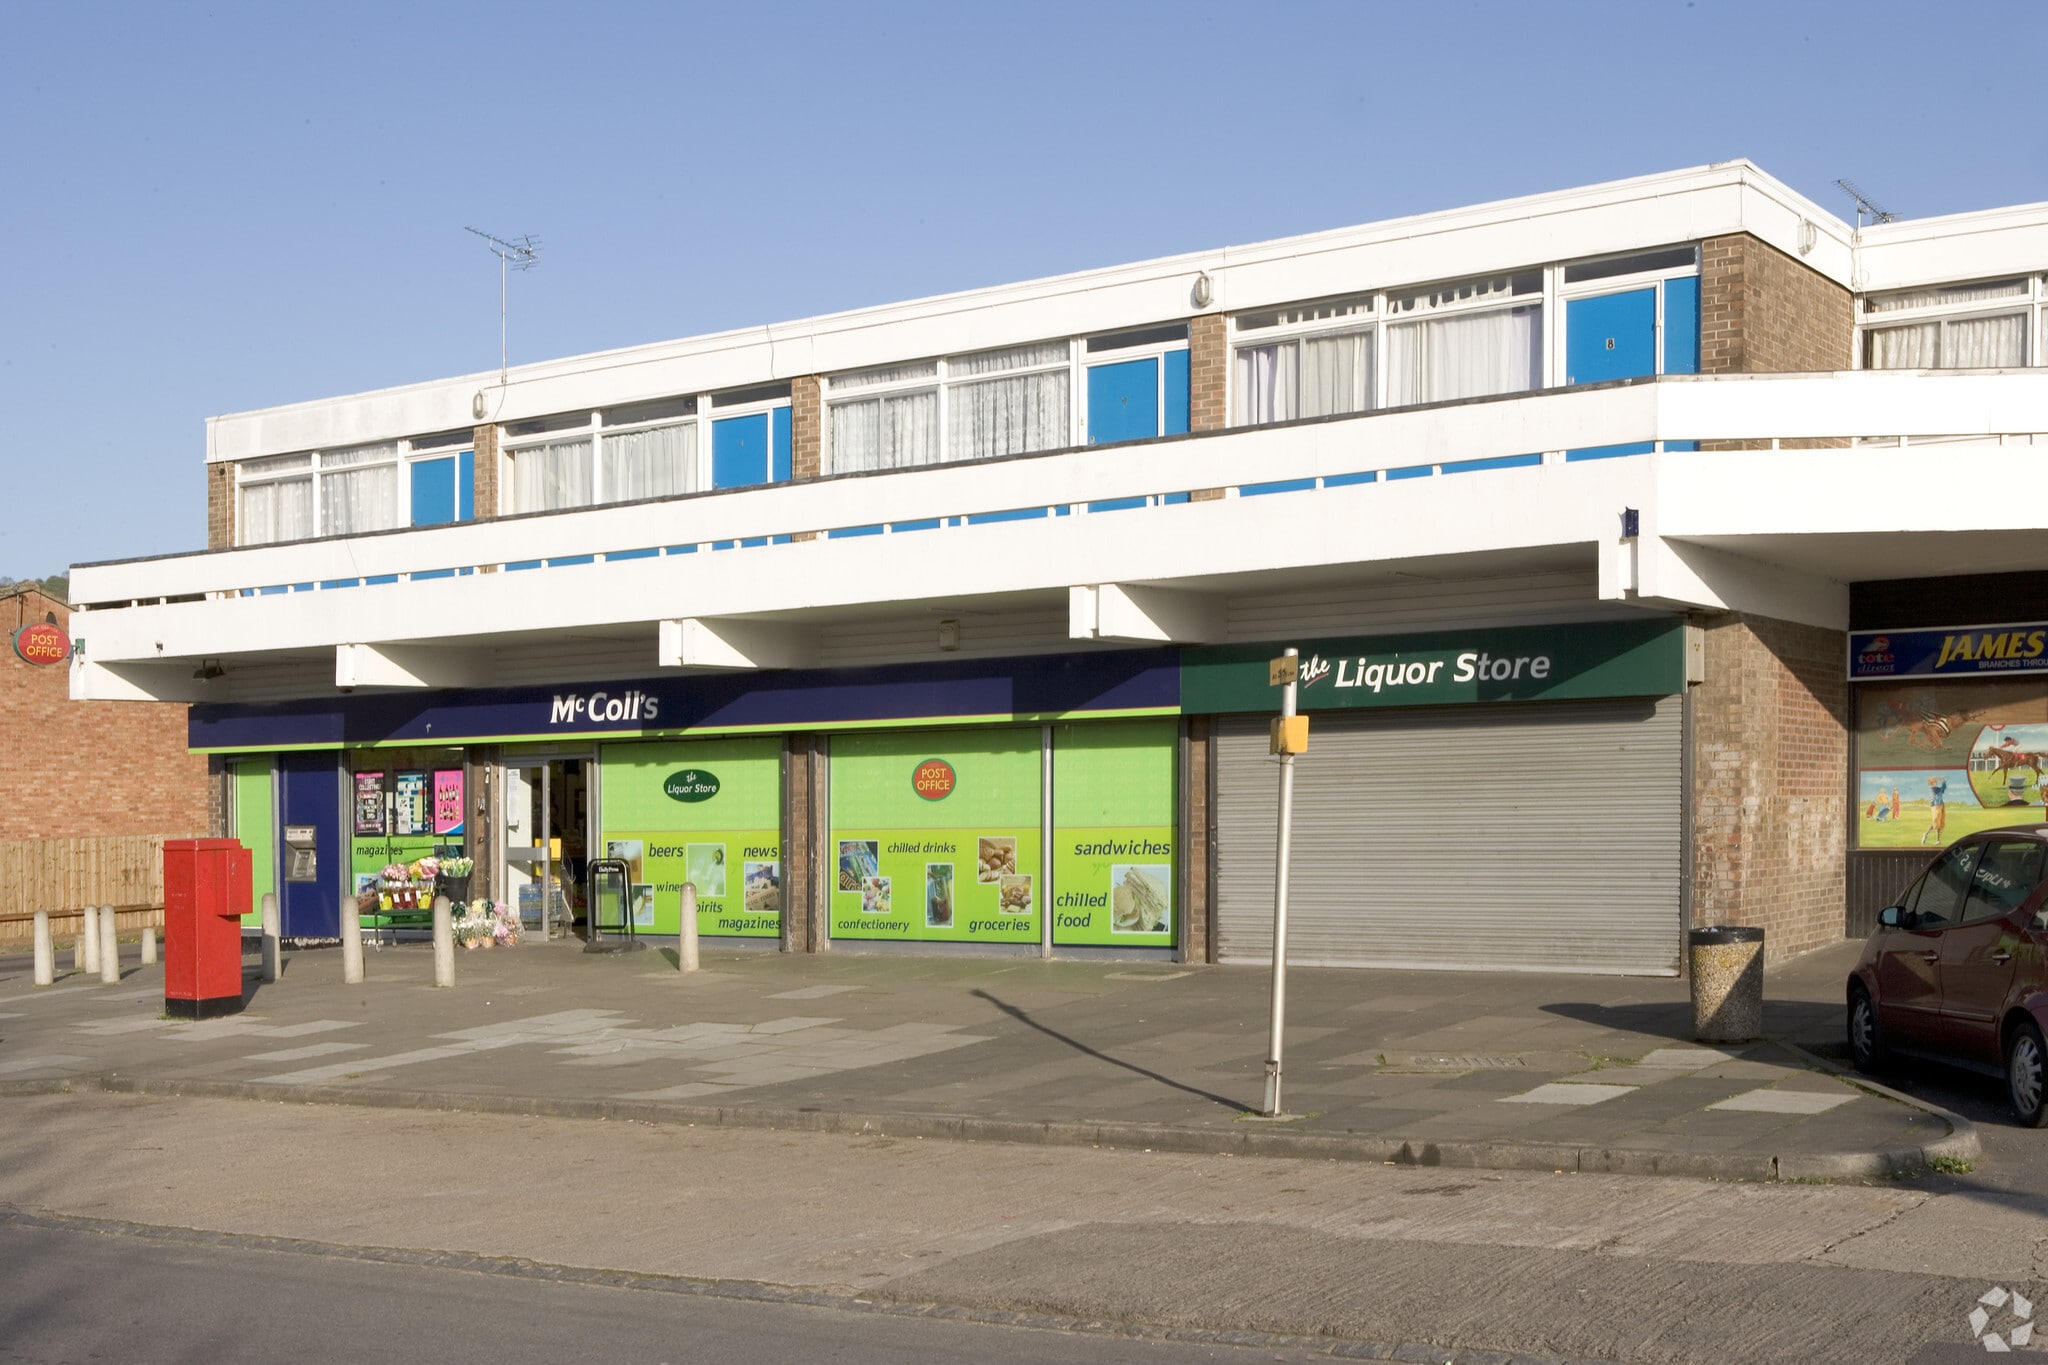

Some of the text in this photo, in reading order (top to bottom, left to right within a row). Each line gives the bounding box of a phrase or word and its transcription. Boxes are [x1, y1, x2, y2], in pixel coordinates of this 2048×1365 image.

[1607, 338, 1614, 349] 8
[31, 634, 58, 645] POST
[26, 645, 62, 657] OFFICE
[1934, 630, 2046, 669] JAMES
[1857, 652, 1895, 664] tote
[1978, 659, 2021, 669] BRANCHES
[1300, 653, 1330, 681] the
[1334, 658, 1443, 693] Liquor
[1453, 652, 1551, 682] Store
[1857, 664, 1895, 673] direct
[921, 768, 947, 779] POST
[667, 783, 717, 794] Liquor Store
[916, 779, 950, 791] OFFICE
[648, 843, 684, 858] beers
[743, 845, 778, 858] news
[887, 842, 956, 854] chilled drinks
[1074, 838, 1171, 857] sandwiches
[1056, 891, 1108, 908] chilled
[718, 918, 781, 931] magazines
[837, 917, 910, 932] confectionery
[968, 917, 1031, 934] groceries
[1056, 912, 1091, 928] food
